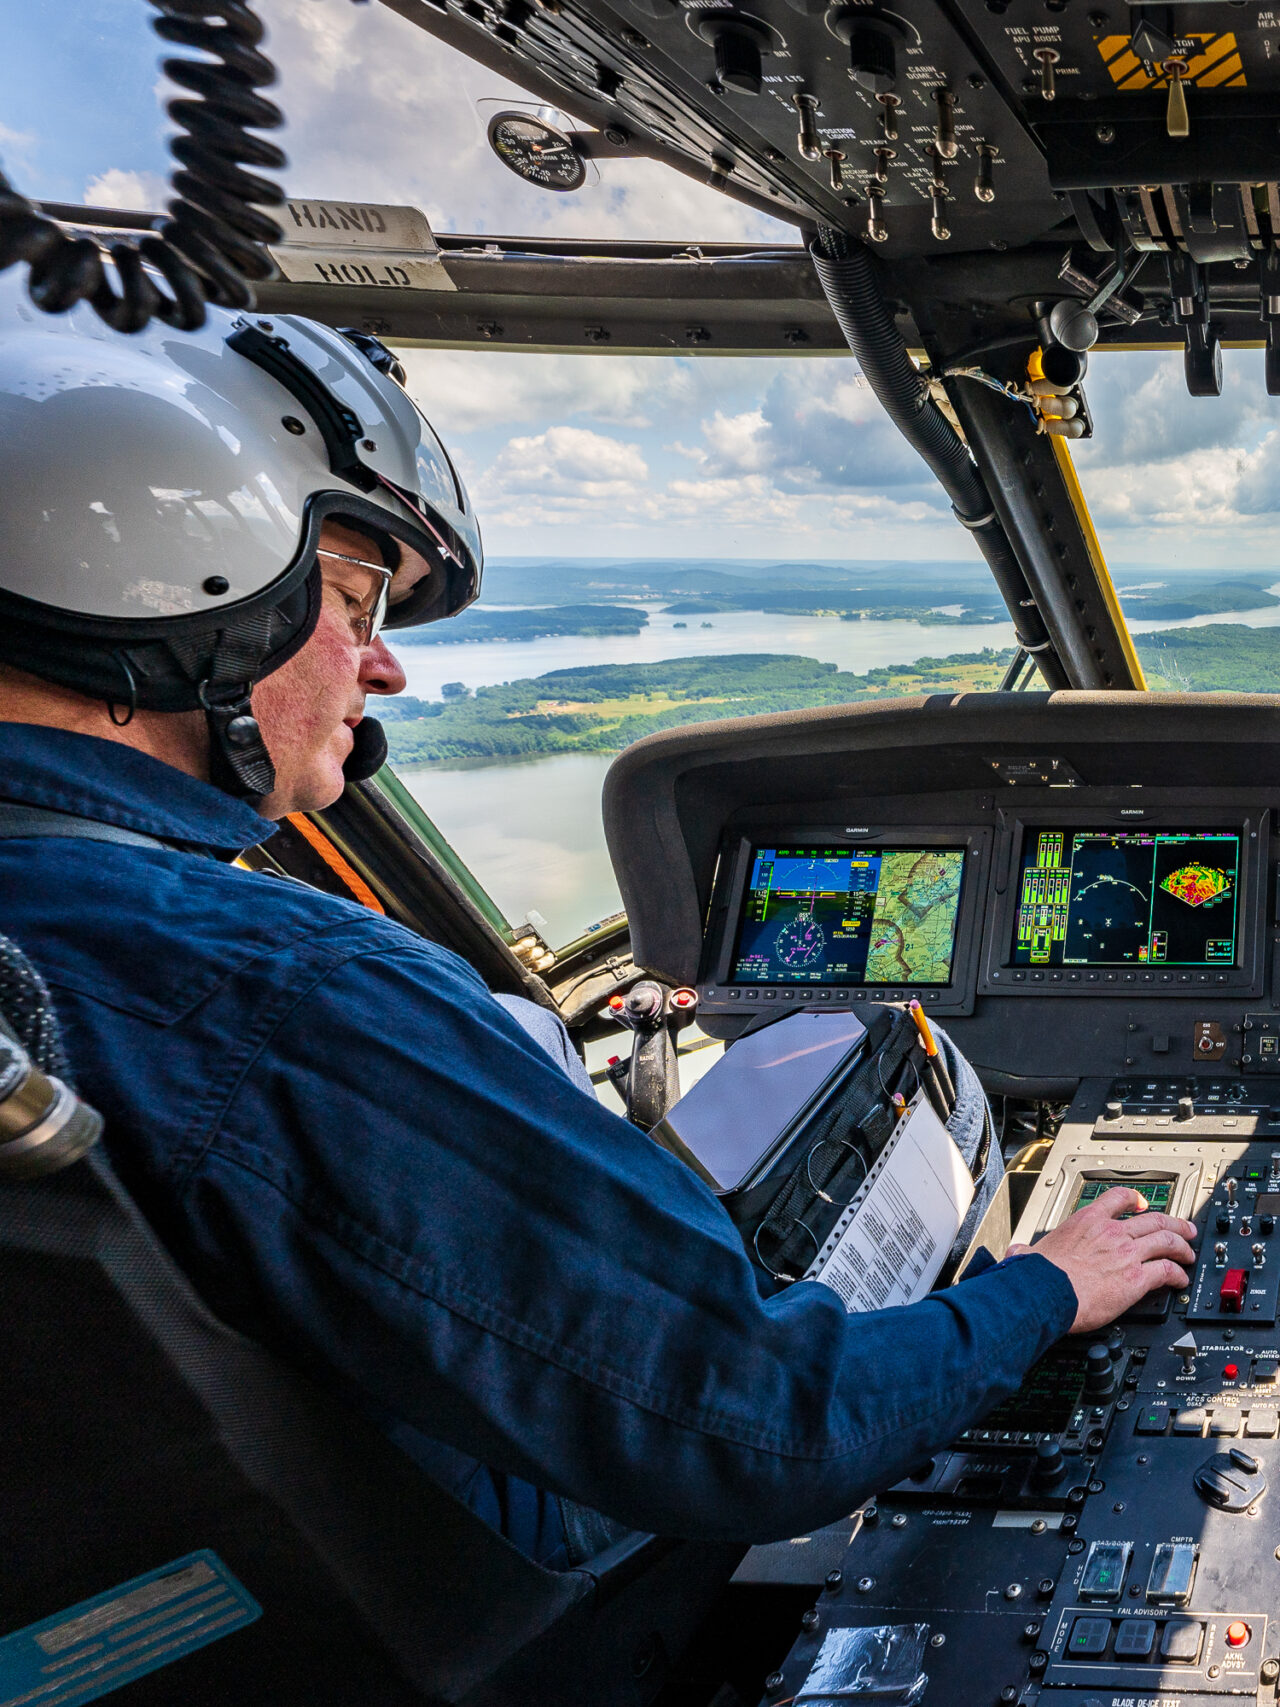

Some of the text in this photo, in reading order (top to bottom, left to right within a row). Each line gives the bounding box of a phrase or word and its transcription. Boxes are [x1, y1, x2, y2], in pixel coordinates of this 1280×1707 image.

[1258, 12, 1274, 20] AIR
[1005, 26, 1060, 35] FUEL PUMP
[1033, 35, 1062, 43] BOOST
[762, 75, 783, 83] NAV
[288, 203, 387, 233] HAND
[314, 262, 411, 286] HOLD
[1134, 1608, 1168, 1616] ADVISORY
[1221, 1661, 1246, 1669] ADVSY
[1112, 1698, 1134, 1707] BLADE
[1137, 1699, 1159, 1707] DE-ICE
